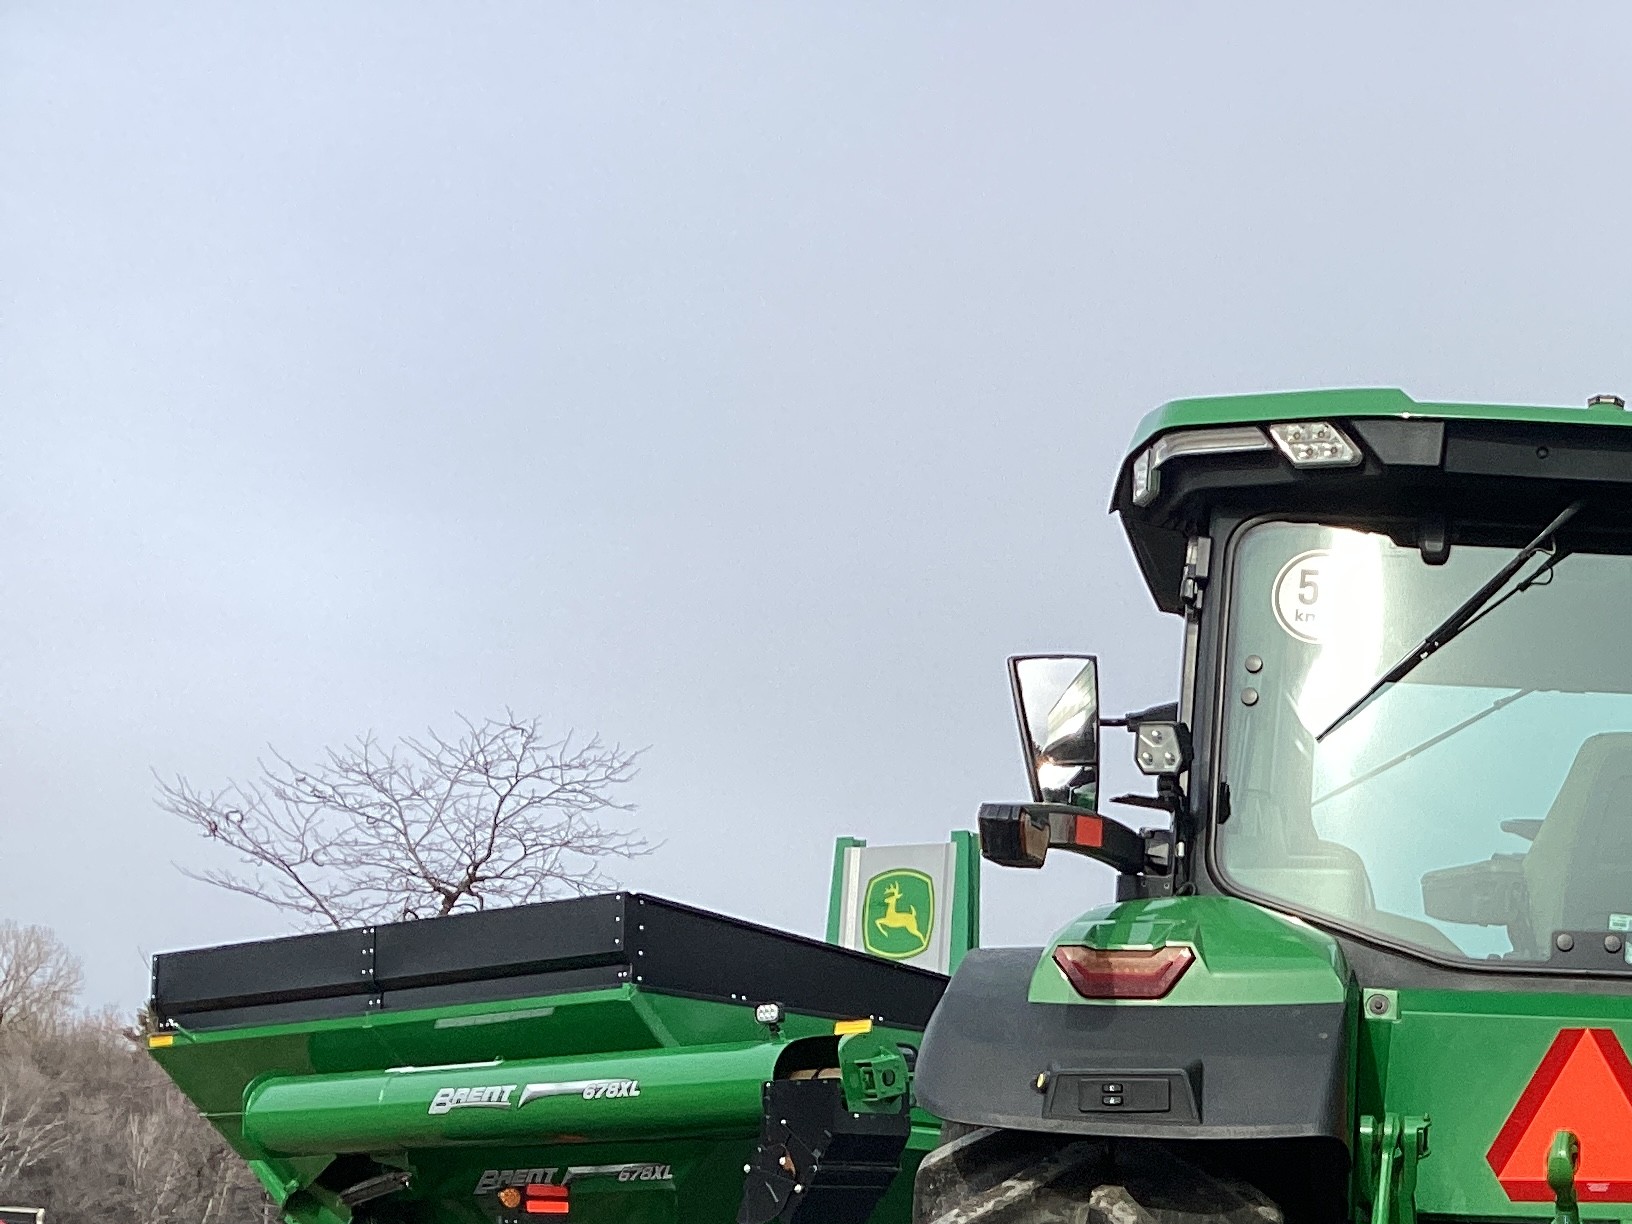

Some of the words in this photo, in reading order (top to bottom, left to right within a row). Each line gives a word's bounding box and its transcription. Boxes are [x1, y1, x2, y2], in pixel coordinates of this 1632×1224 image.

[428, 1084, 517, 1115] BRENT
[582, 1080, 641, 1100] 678XL
[473, 1167, 559, 1195] BRENT
[618, 1164, 674, 1182] 678XL
